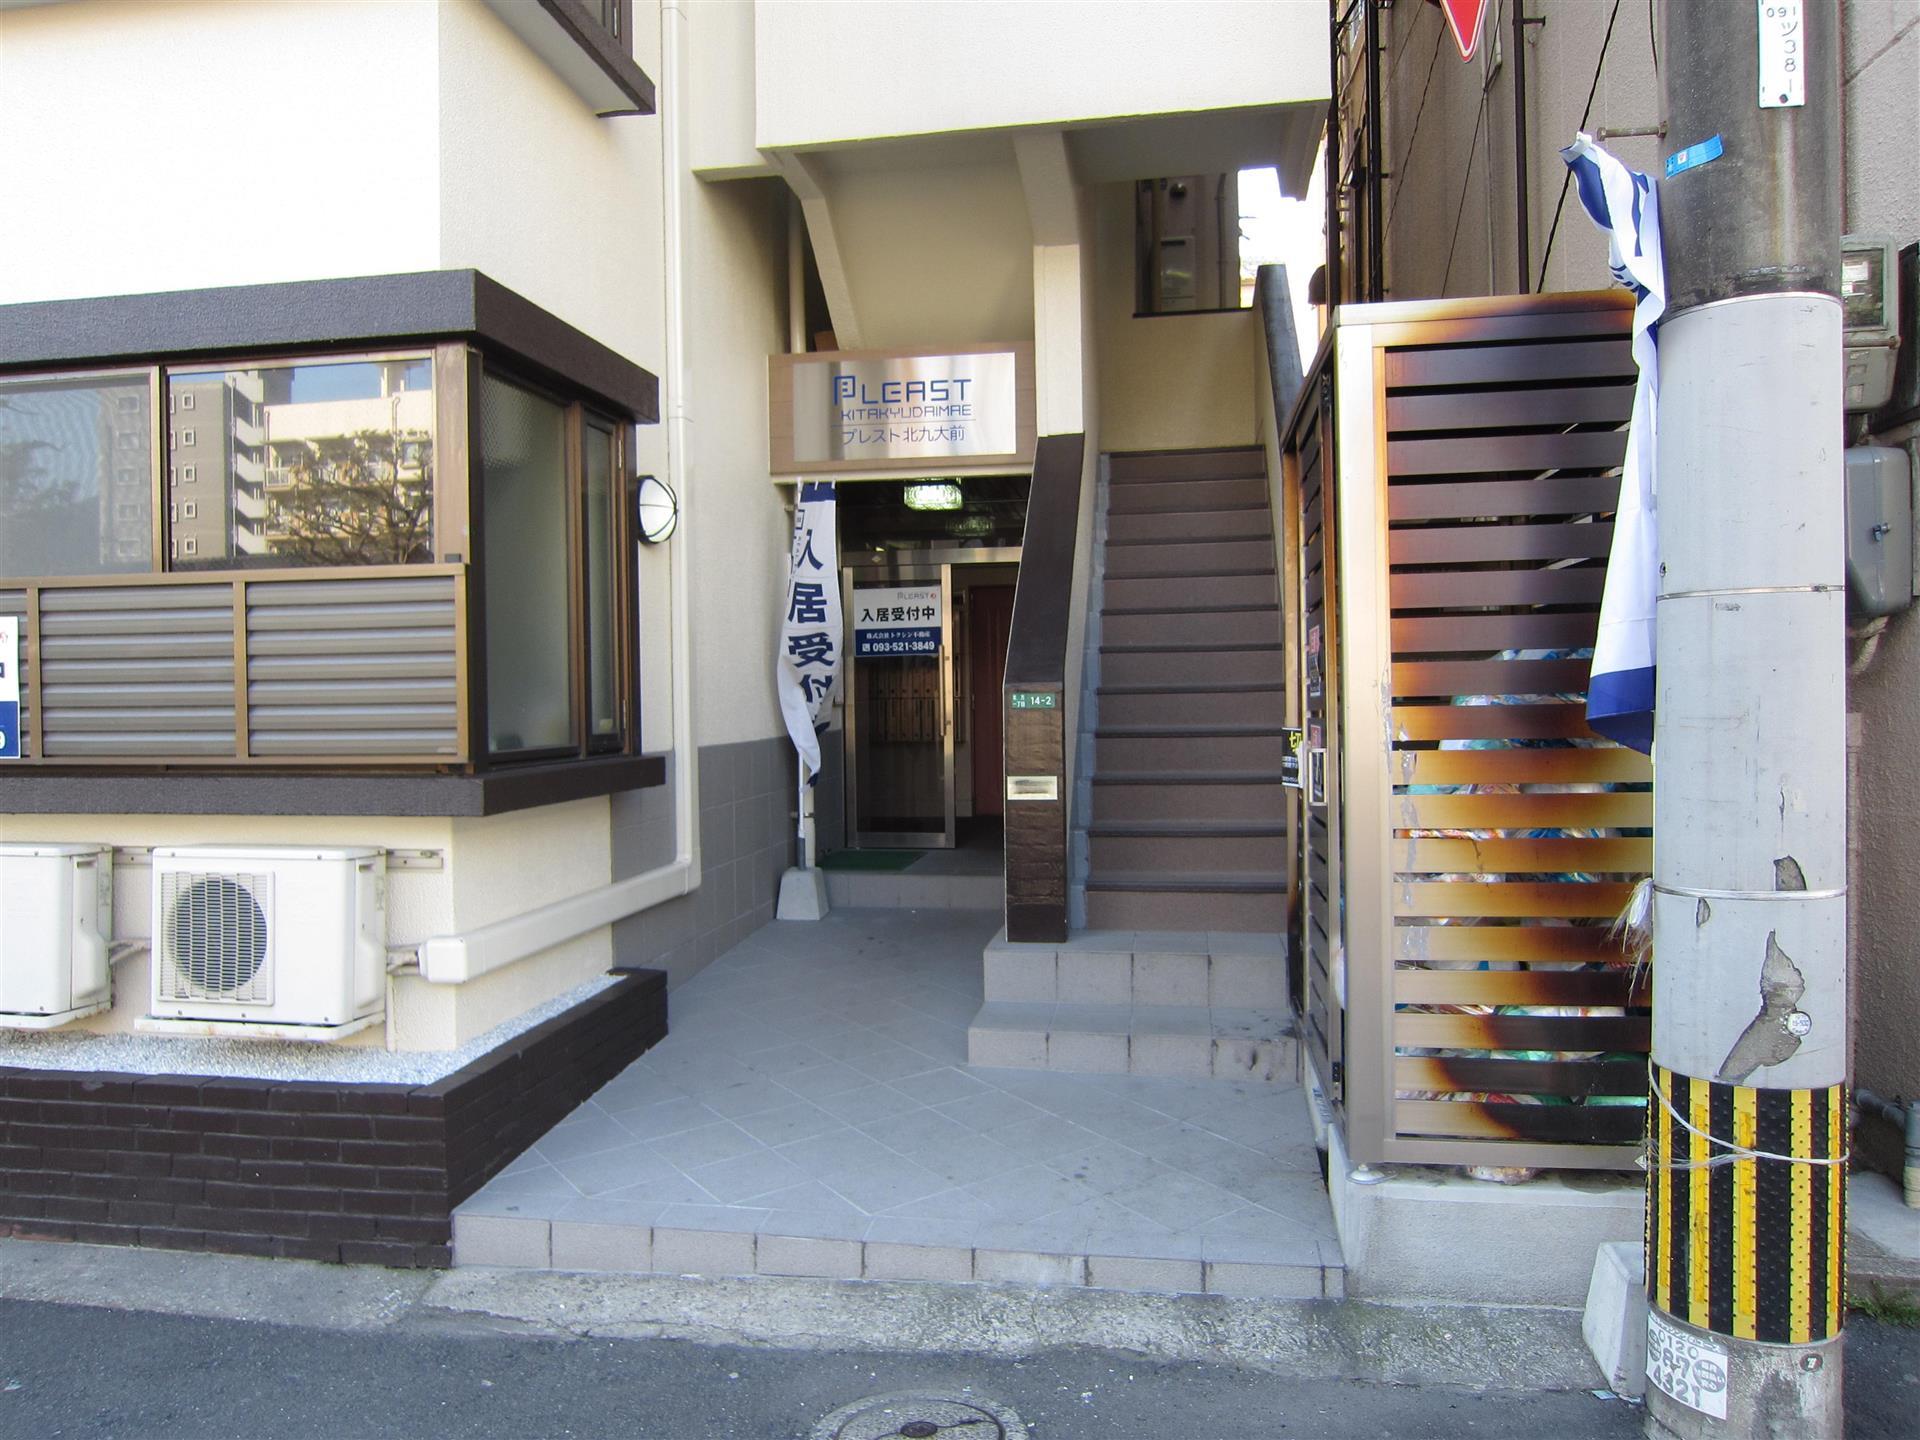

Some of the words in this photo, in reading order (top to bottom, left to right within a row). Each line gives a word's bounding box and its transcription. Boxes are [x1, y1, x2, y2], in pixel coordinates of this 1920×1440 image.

[833, 375, 972, 406] PLEAST
[840, 404, 972, 422] KITAKYUDAIMAE
[842, 425, 966, 446] プレスト北九大前
[861, 606, 935, 622] 入居受付中
[872, 641, 935, 652] 093-521-3849
[1030, 695, 1052, 706] 14-2
[1658, 1328, 1699, 1360] 0120
[1653, 1364, 1701, 1408] 4321
